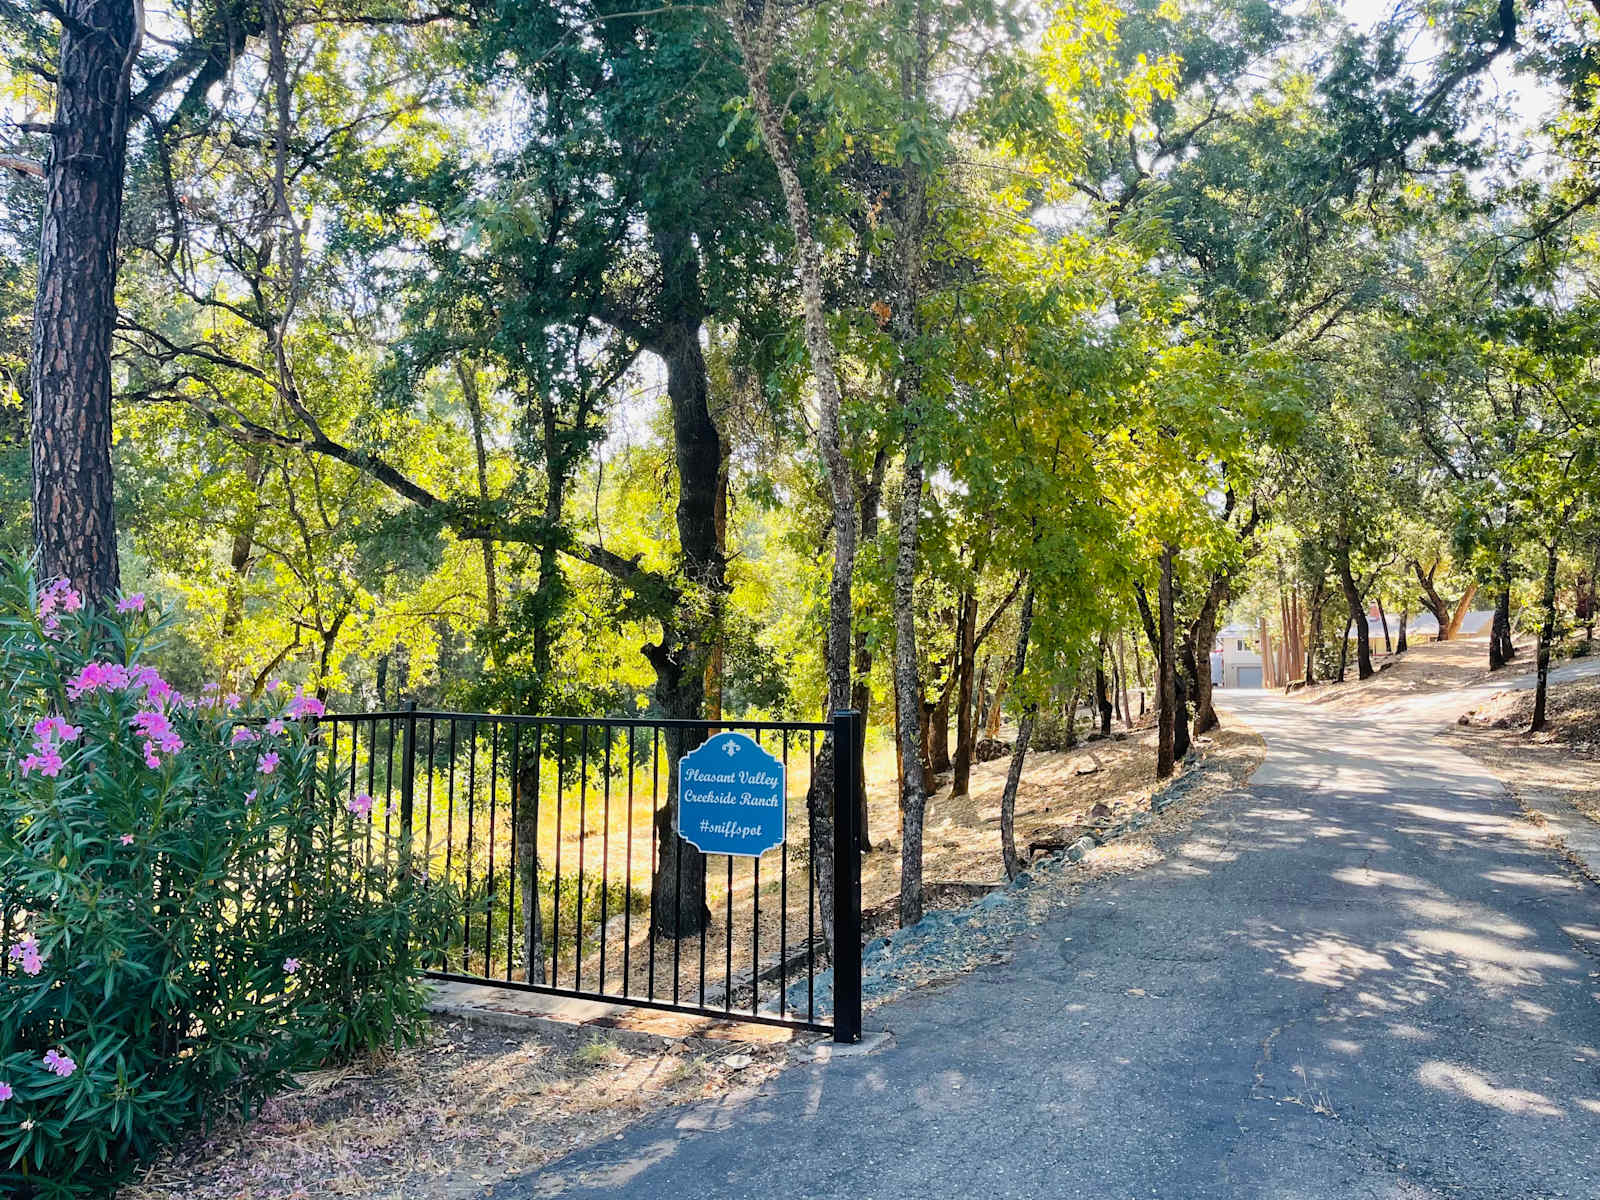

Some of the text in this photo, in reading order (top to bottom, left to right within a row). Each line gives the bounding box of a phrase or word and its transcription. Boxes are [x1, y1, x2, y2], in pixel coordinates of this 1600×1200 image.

[684, 768, 779, 789] Pleasant Valley
[684, 789, 778, 807] Creekside Ranch
[699, 818, 763, 838] #sniffspot
